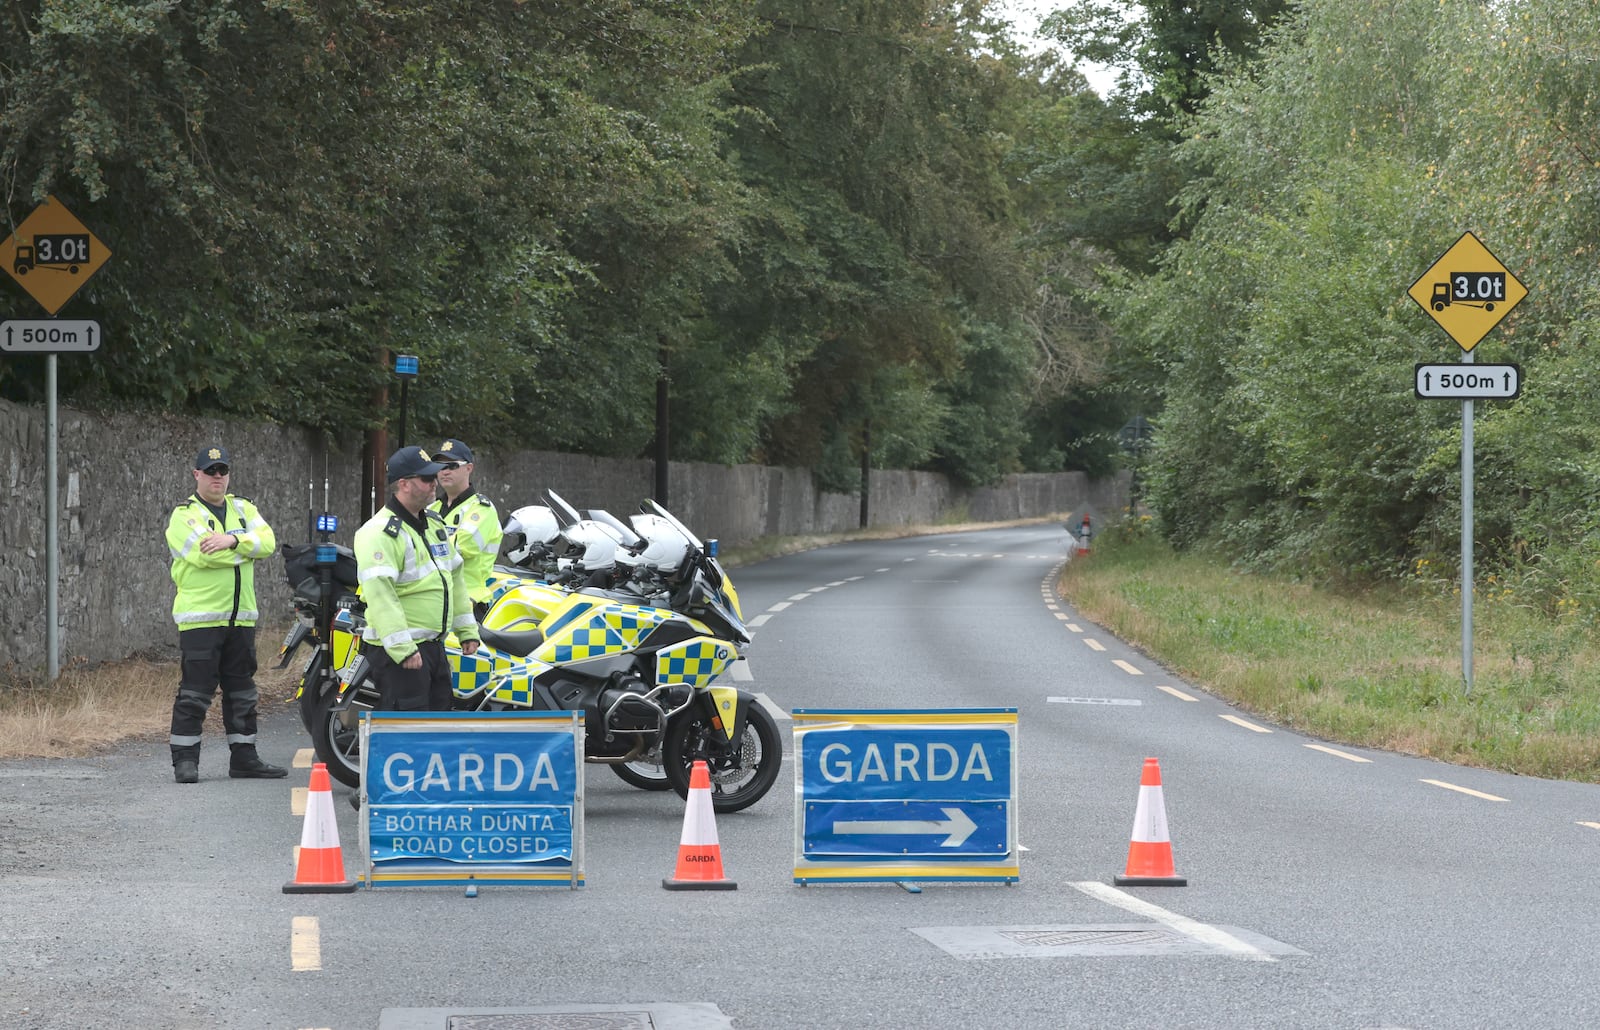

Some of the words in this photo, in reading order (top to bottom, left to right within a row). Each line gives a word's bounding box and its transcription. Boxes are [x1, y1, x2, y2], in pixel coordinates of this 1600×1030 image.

[38, 238, 86, 260] 3.0t
[1454, 276, 1502, 298] 3.0t
[23, 328, 77, 343] 500m
[1440, 374, 1494, 388] 500m
[383, 752, 560, 793] GARDA
[819, 742, 993, 783] GARDA
[386, 812, 472, 832] BÓTHAR
[481, 811, 554, 831] DÚNTA
[392, 837, 453, 854] ROAD
[461, 837, 550, 854] CLOSED
[685, 855, 716, 863] GARDA
